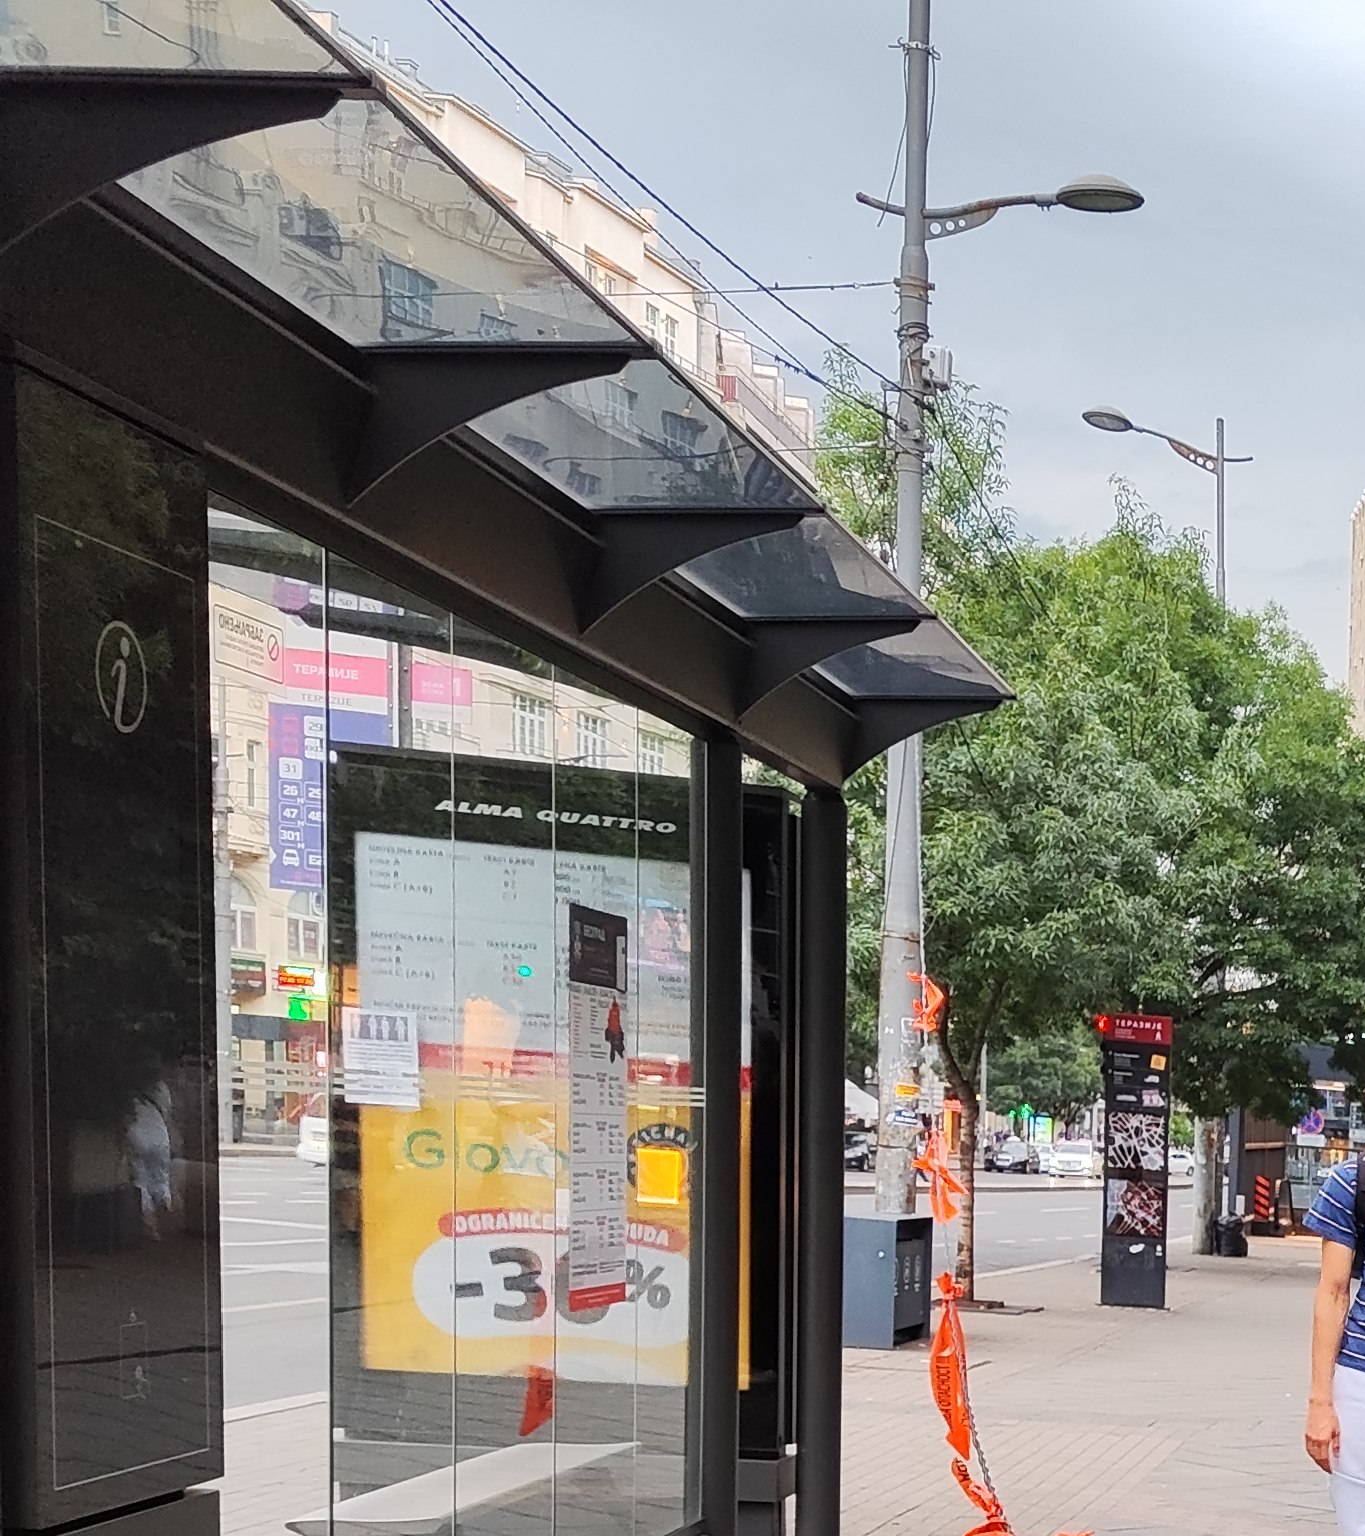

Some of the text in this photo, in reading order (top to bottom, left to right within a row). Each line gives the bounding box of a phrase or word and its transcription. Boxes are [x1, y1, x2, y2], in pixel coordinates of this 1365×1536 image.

[301, 692, 352, 707] TERZIJE
[284, 763, 297, 774] 31
[283, 785, 298, 797] 26
[283, 808, 298, 819] 47
[434, 799, 677, 834] ALMA QUATTRO
[1115, 1018, 1162, 1031] ТЕРАЗИЈЕ
